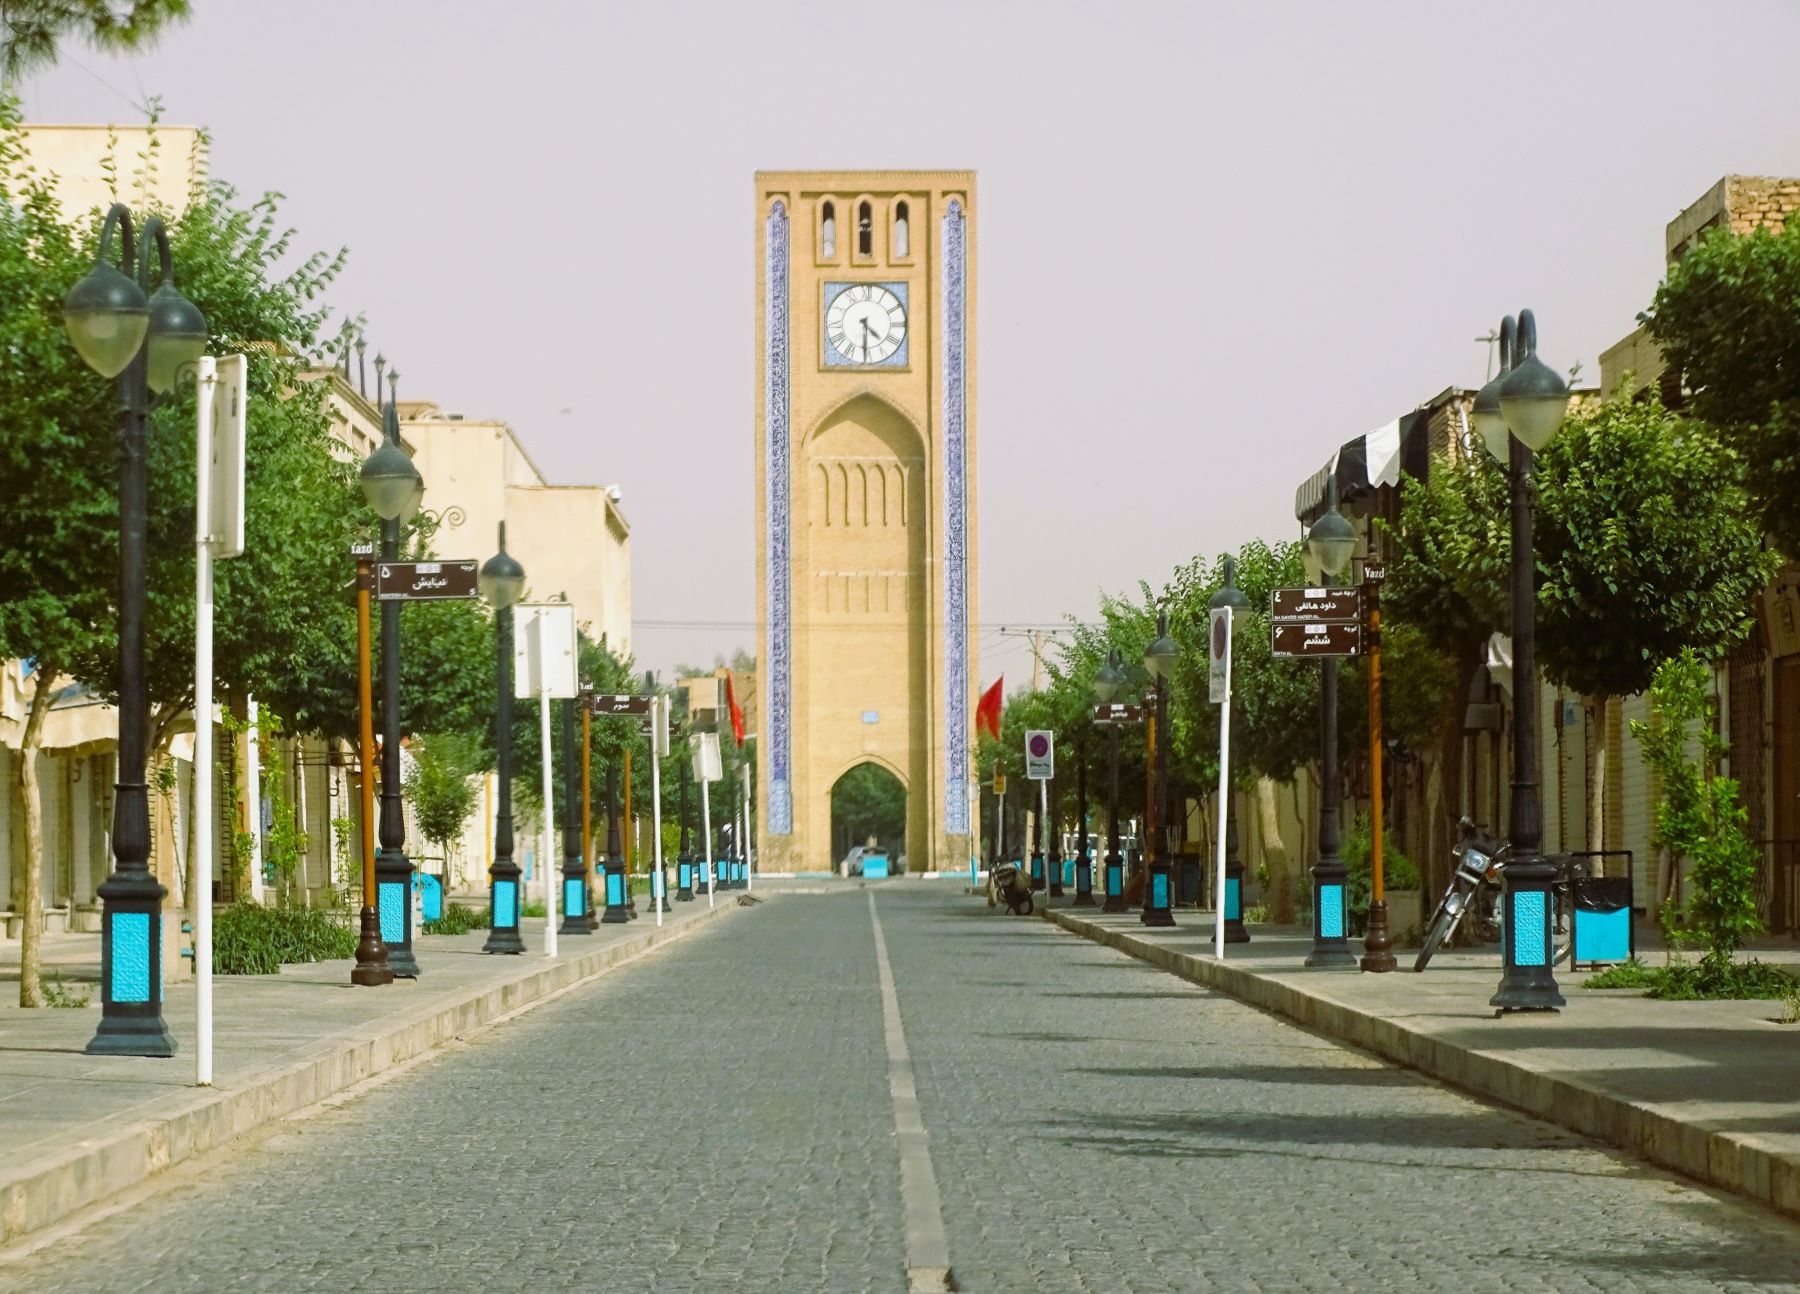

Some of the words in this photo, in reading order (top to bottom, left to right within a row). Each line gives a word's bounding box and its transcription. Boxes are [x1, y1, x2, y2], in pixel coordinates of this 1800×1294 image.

[1364, 566, 1385, 579] Yazd
[412, 577, 448, 590] نیایش
[1295, 601, 1319, 612] هاتفی
[1320, 602, 1336, 611] داود
[1303, 635, 1331, 650] ششم
